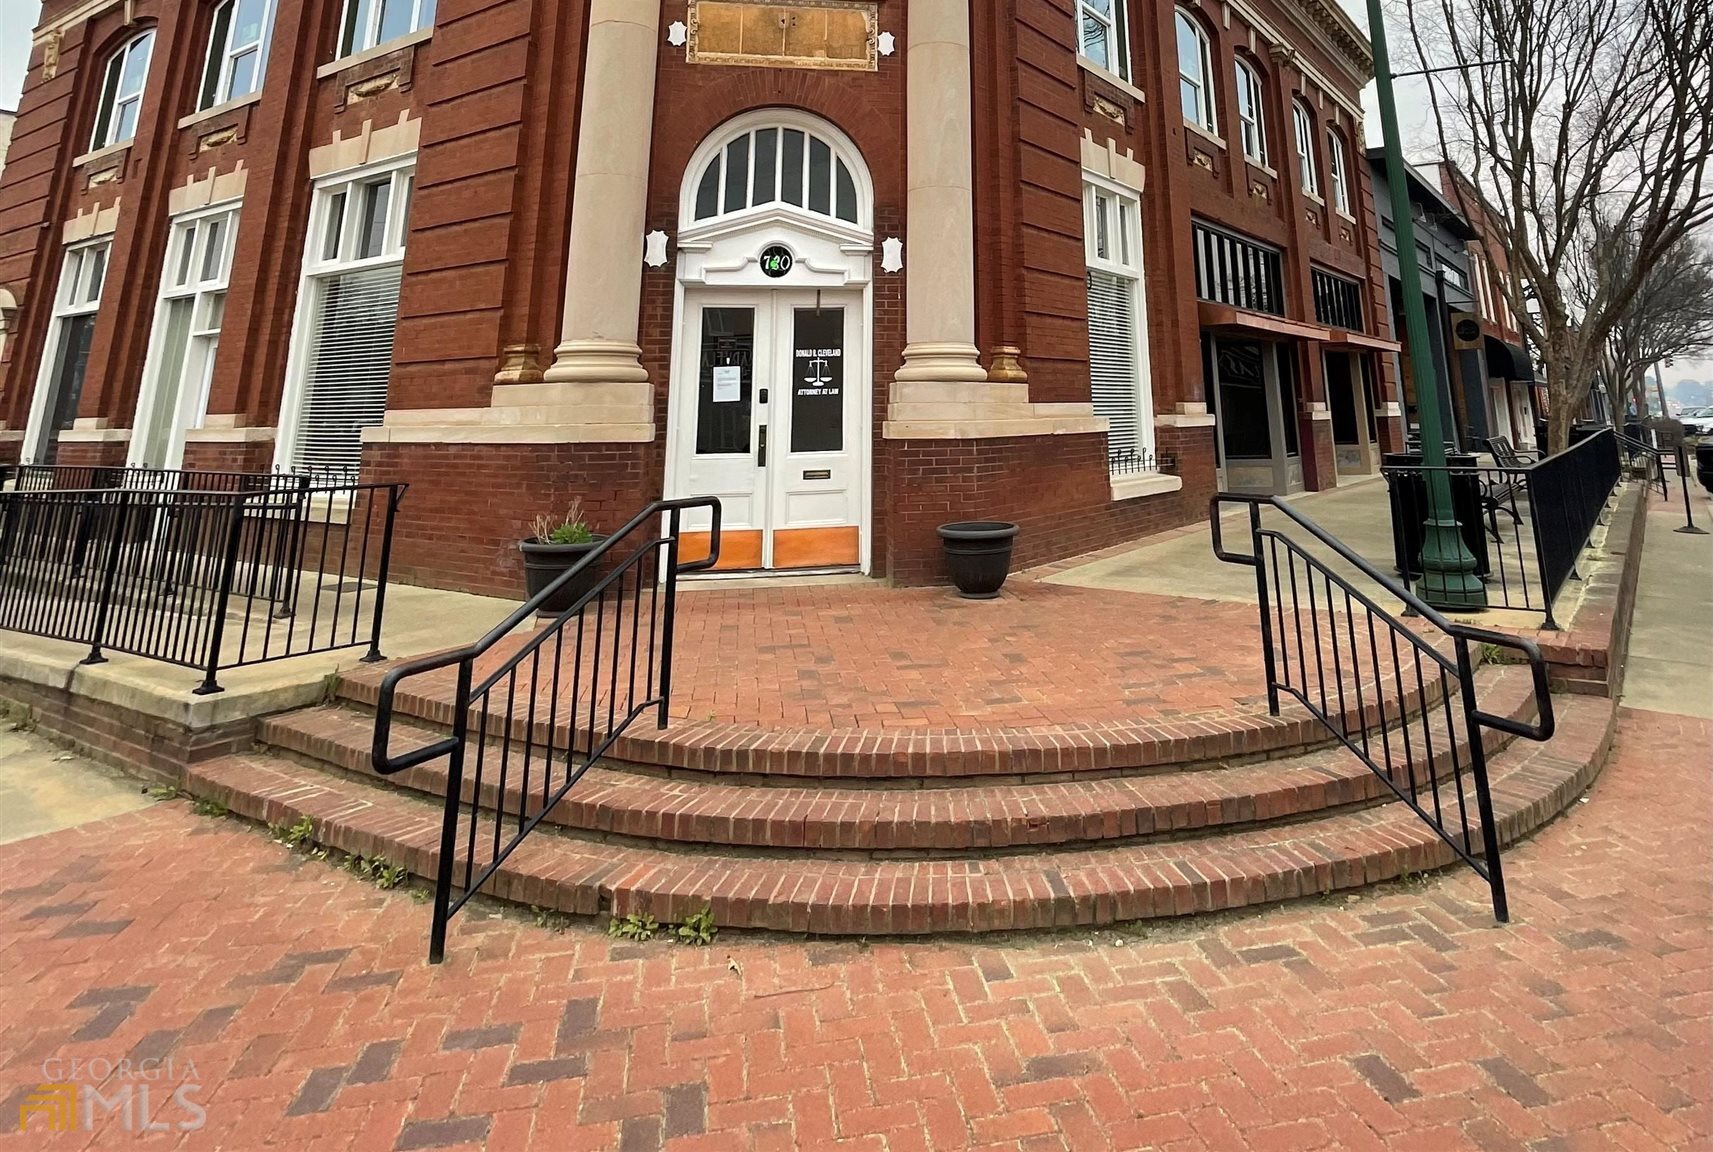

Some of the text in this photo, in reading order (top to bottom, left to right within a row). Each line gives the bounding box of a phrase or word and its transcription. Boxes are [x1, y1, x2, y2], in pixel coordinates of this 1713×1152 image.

[795, 348, 812, 358] DONALD
[818, 348, 841, 357] CLEVELAND
[797, 388, 821, 396] ATTORNEY
